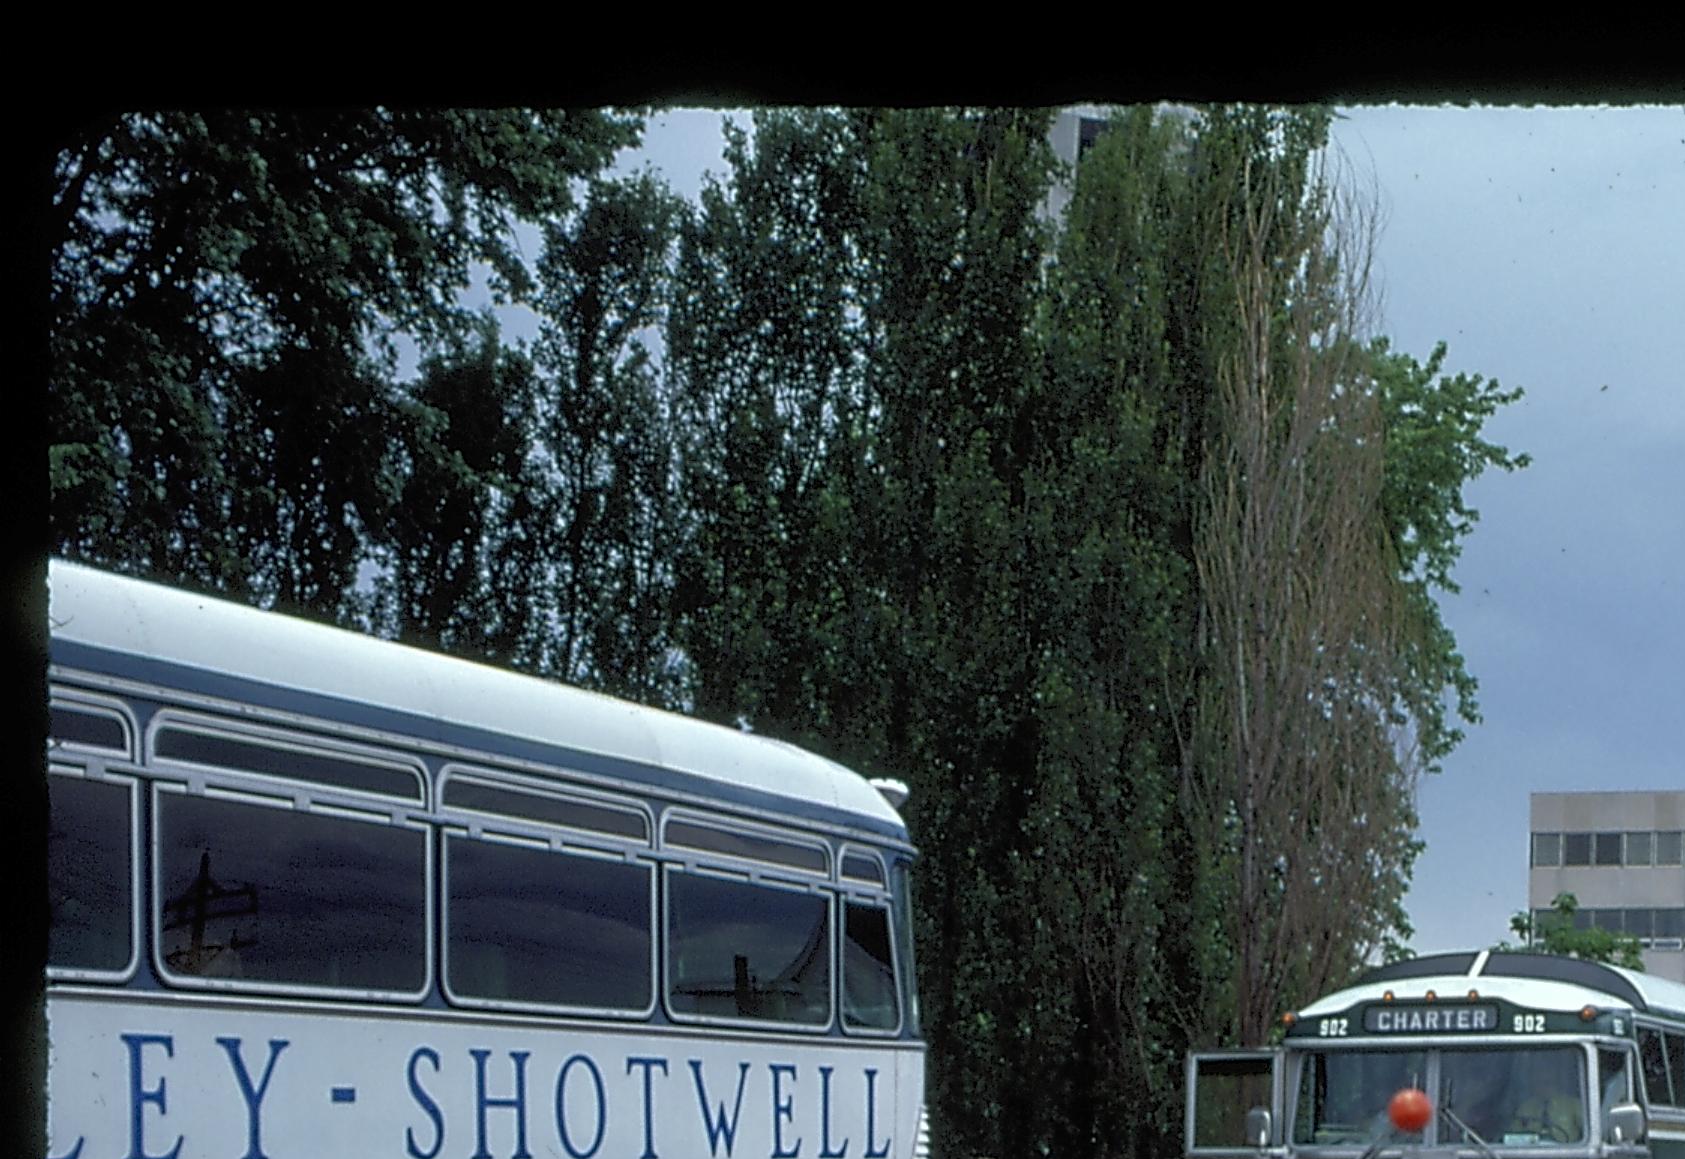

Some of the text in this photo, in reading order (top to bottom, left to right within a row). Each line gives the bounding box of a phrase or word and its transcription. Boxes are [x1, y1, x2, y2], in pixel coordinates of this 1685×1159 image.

[1320, 1018, 1348, 1037] 902
[1377, 1010, 1487, 1032] CHARTER
[1513, 1014, 1545, 1033] 902
